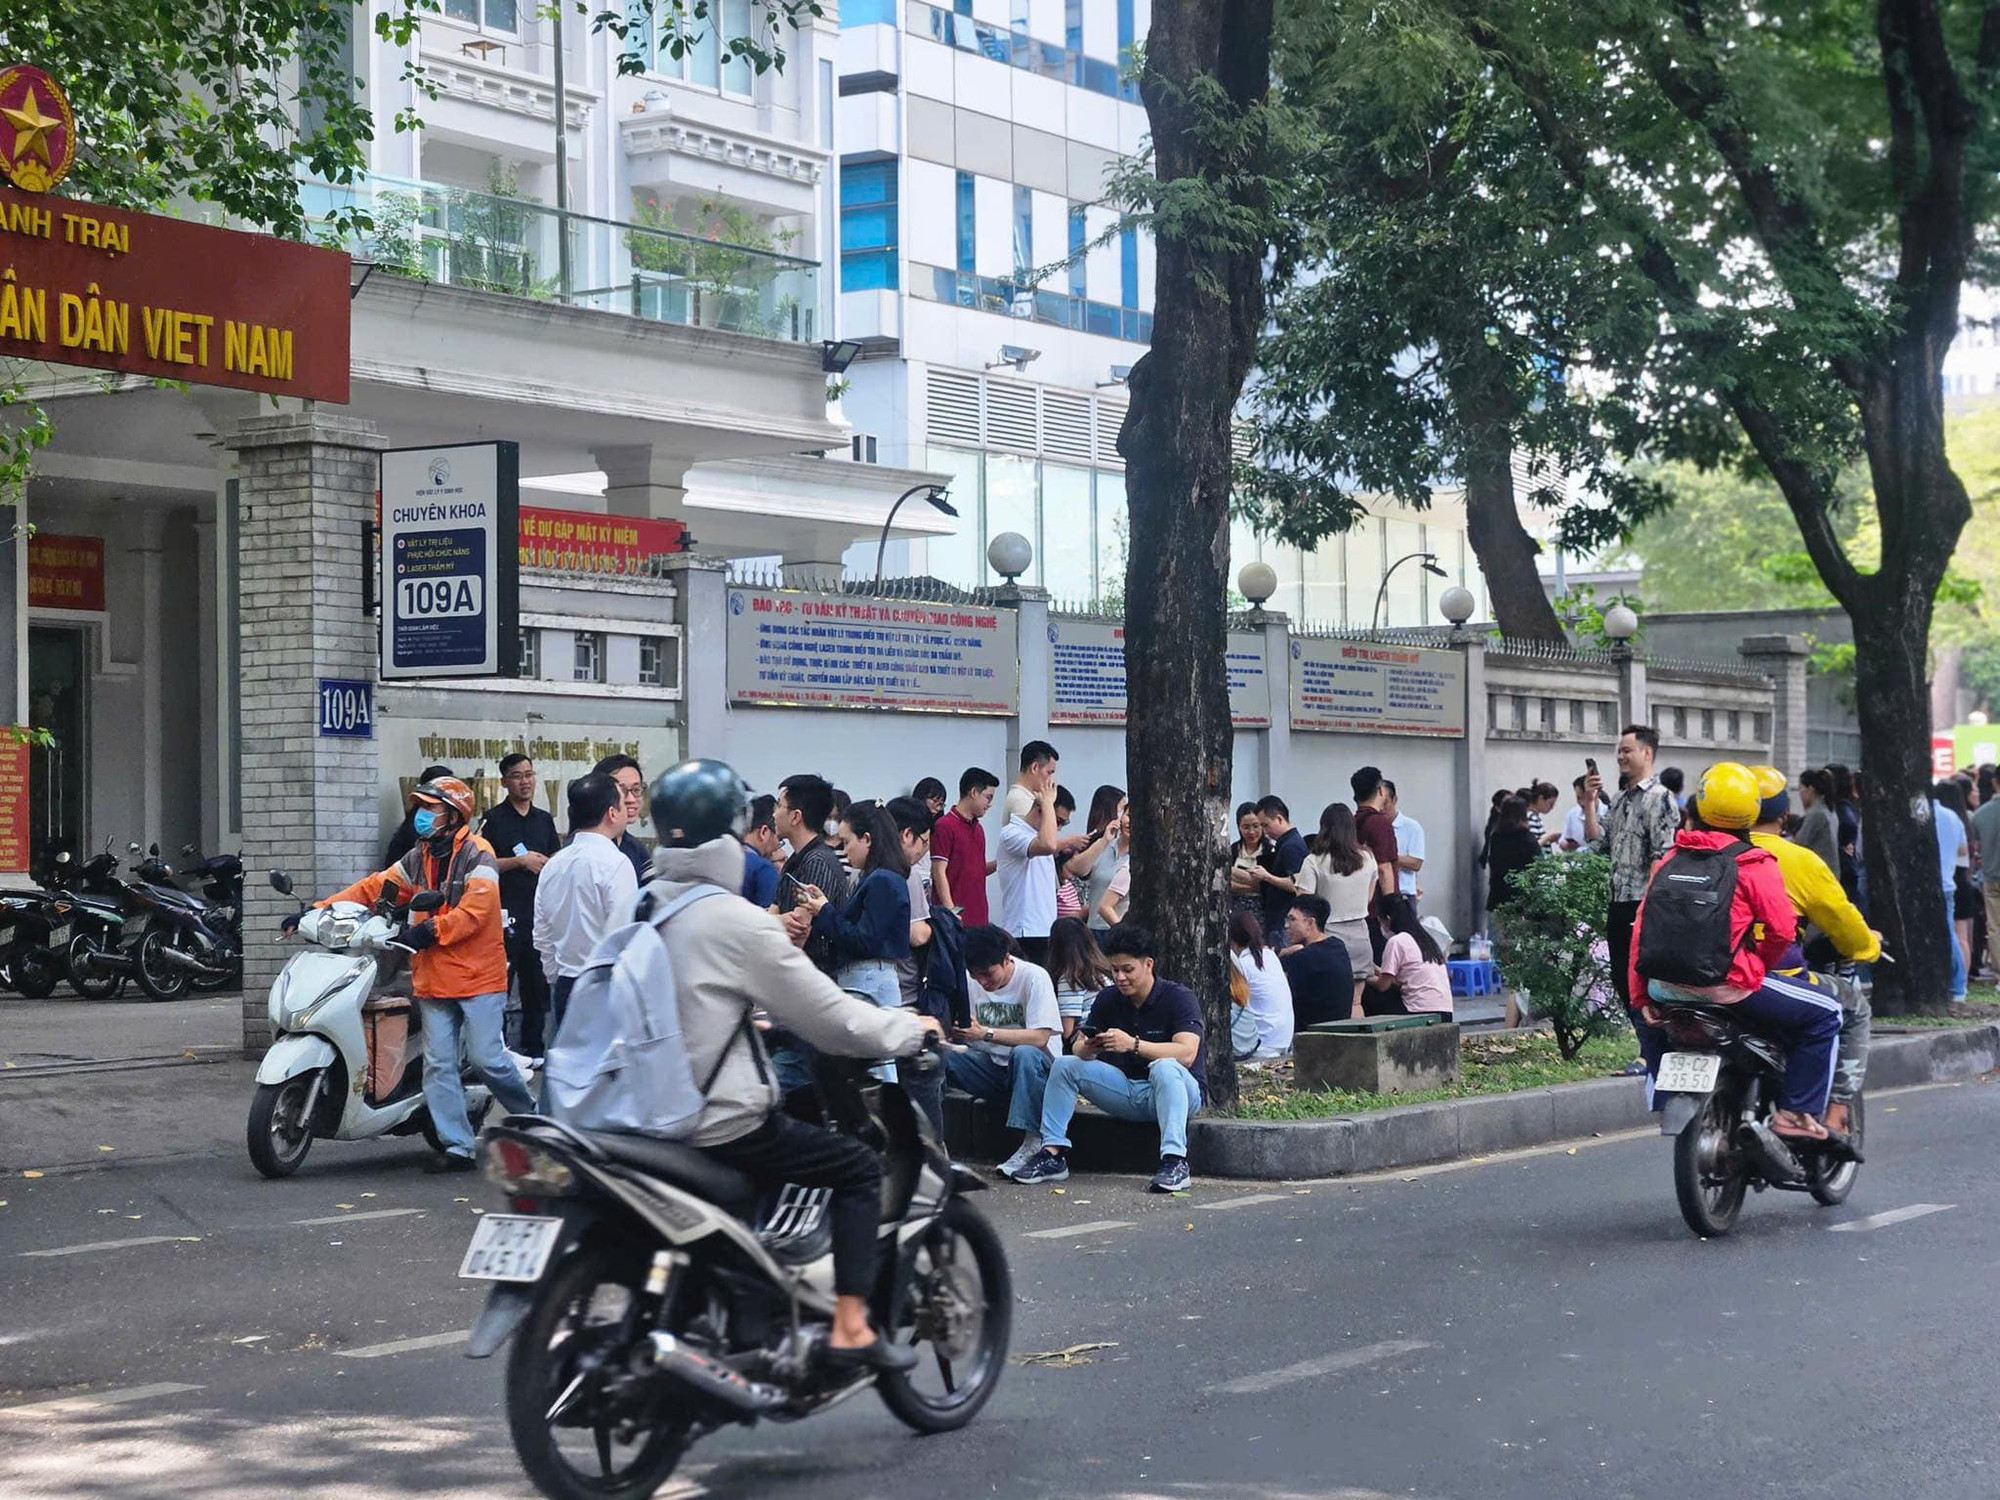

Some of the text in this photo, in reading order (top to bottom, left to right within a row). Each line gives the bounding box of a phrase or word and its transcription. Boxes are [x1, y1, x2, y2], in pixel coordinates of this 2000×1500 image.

[62, 214, 130, 258] TRẠI
[60, 282, 129, 355] DÂN
[224, 320, 293, 380] NAM
[393, 503, 486, 523] CHUYÊN KHOA
[404, 579, 475, 615] 109A
[323, 688, 370, 730] 109A
[418, 731, 447, 760] VIỆN
[449, 738, 481, 760] KHOA
[484, 738, 508, 763] HỌC
[530, 735, 560, 761] CÔNG
